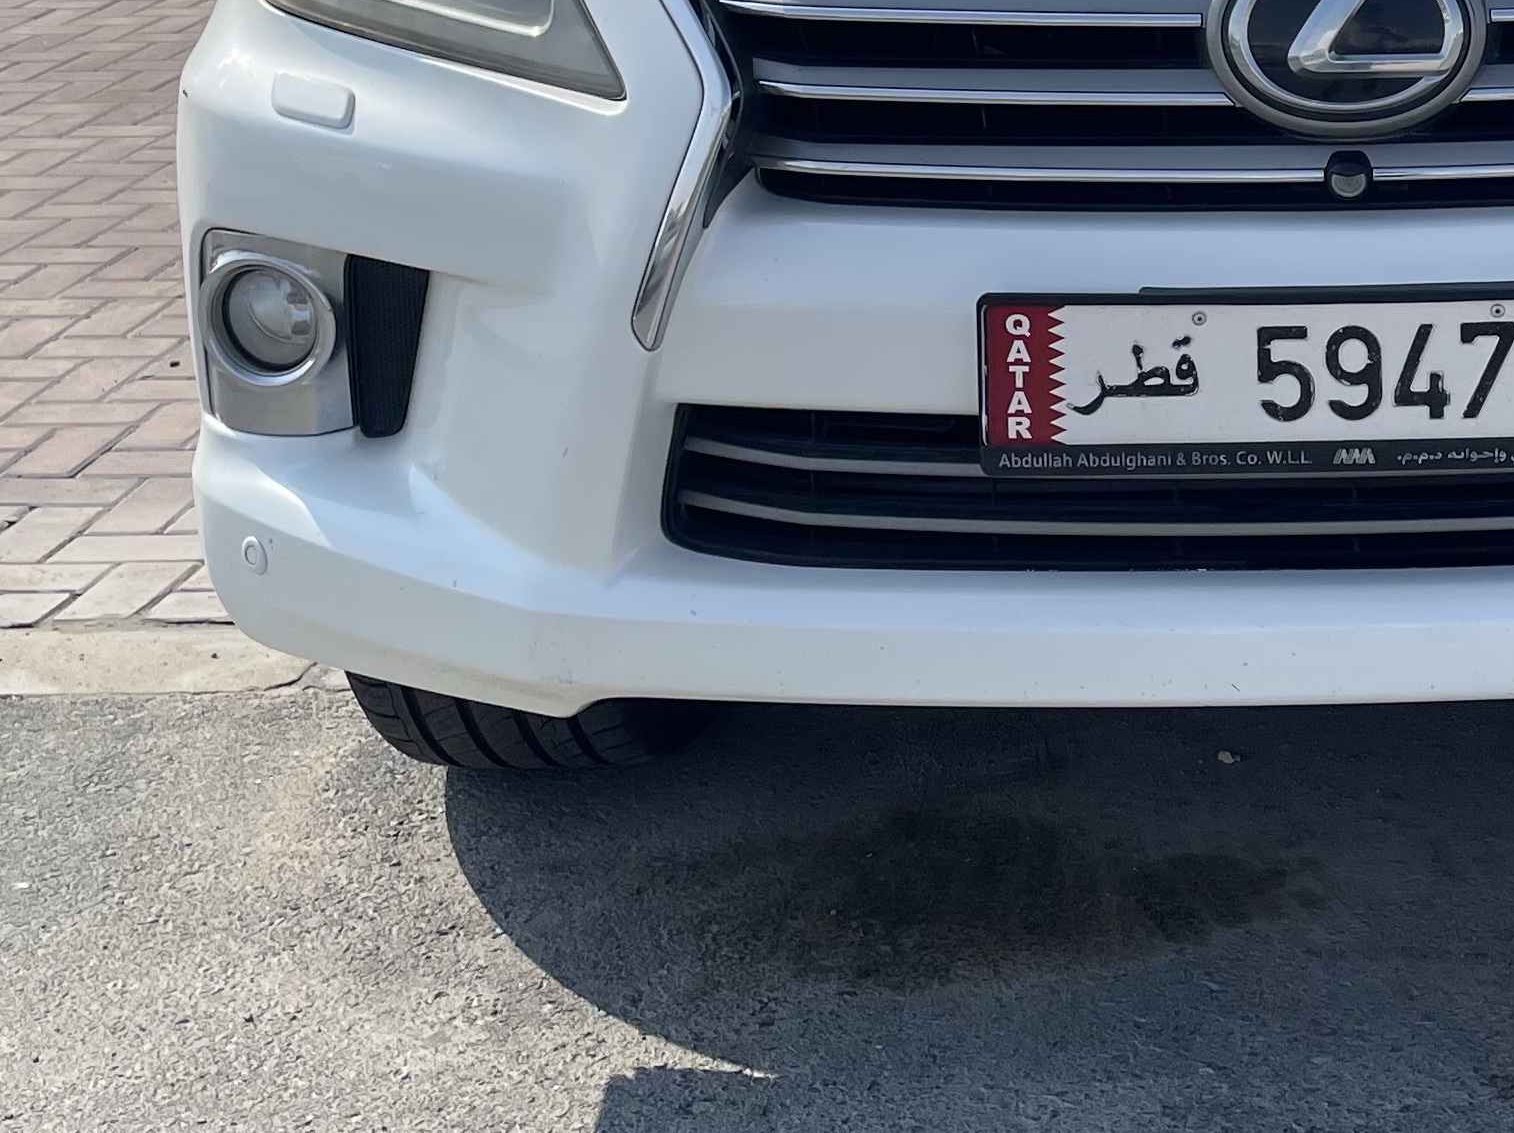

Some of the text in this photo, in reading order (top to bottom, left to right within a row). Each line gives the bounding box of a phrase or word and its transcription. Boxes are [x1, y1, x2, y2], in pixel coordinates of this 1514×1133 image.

[1005, 314, 1033, 440] QATAR
[1066, 334, 1200, 416] قطر
[999, 450, 1313, 471] Abdullah Abdulghani & Bros. Co. W.L.L.
